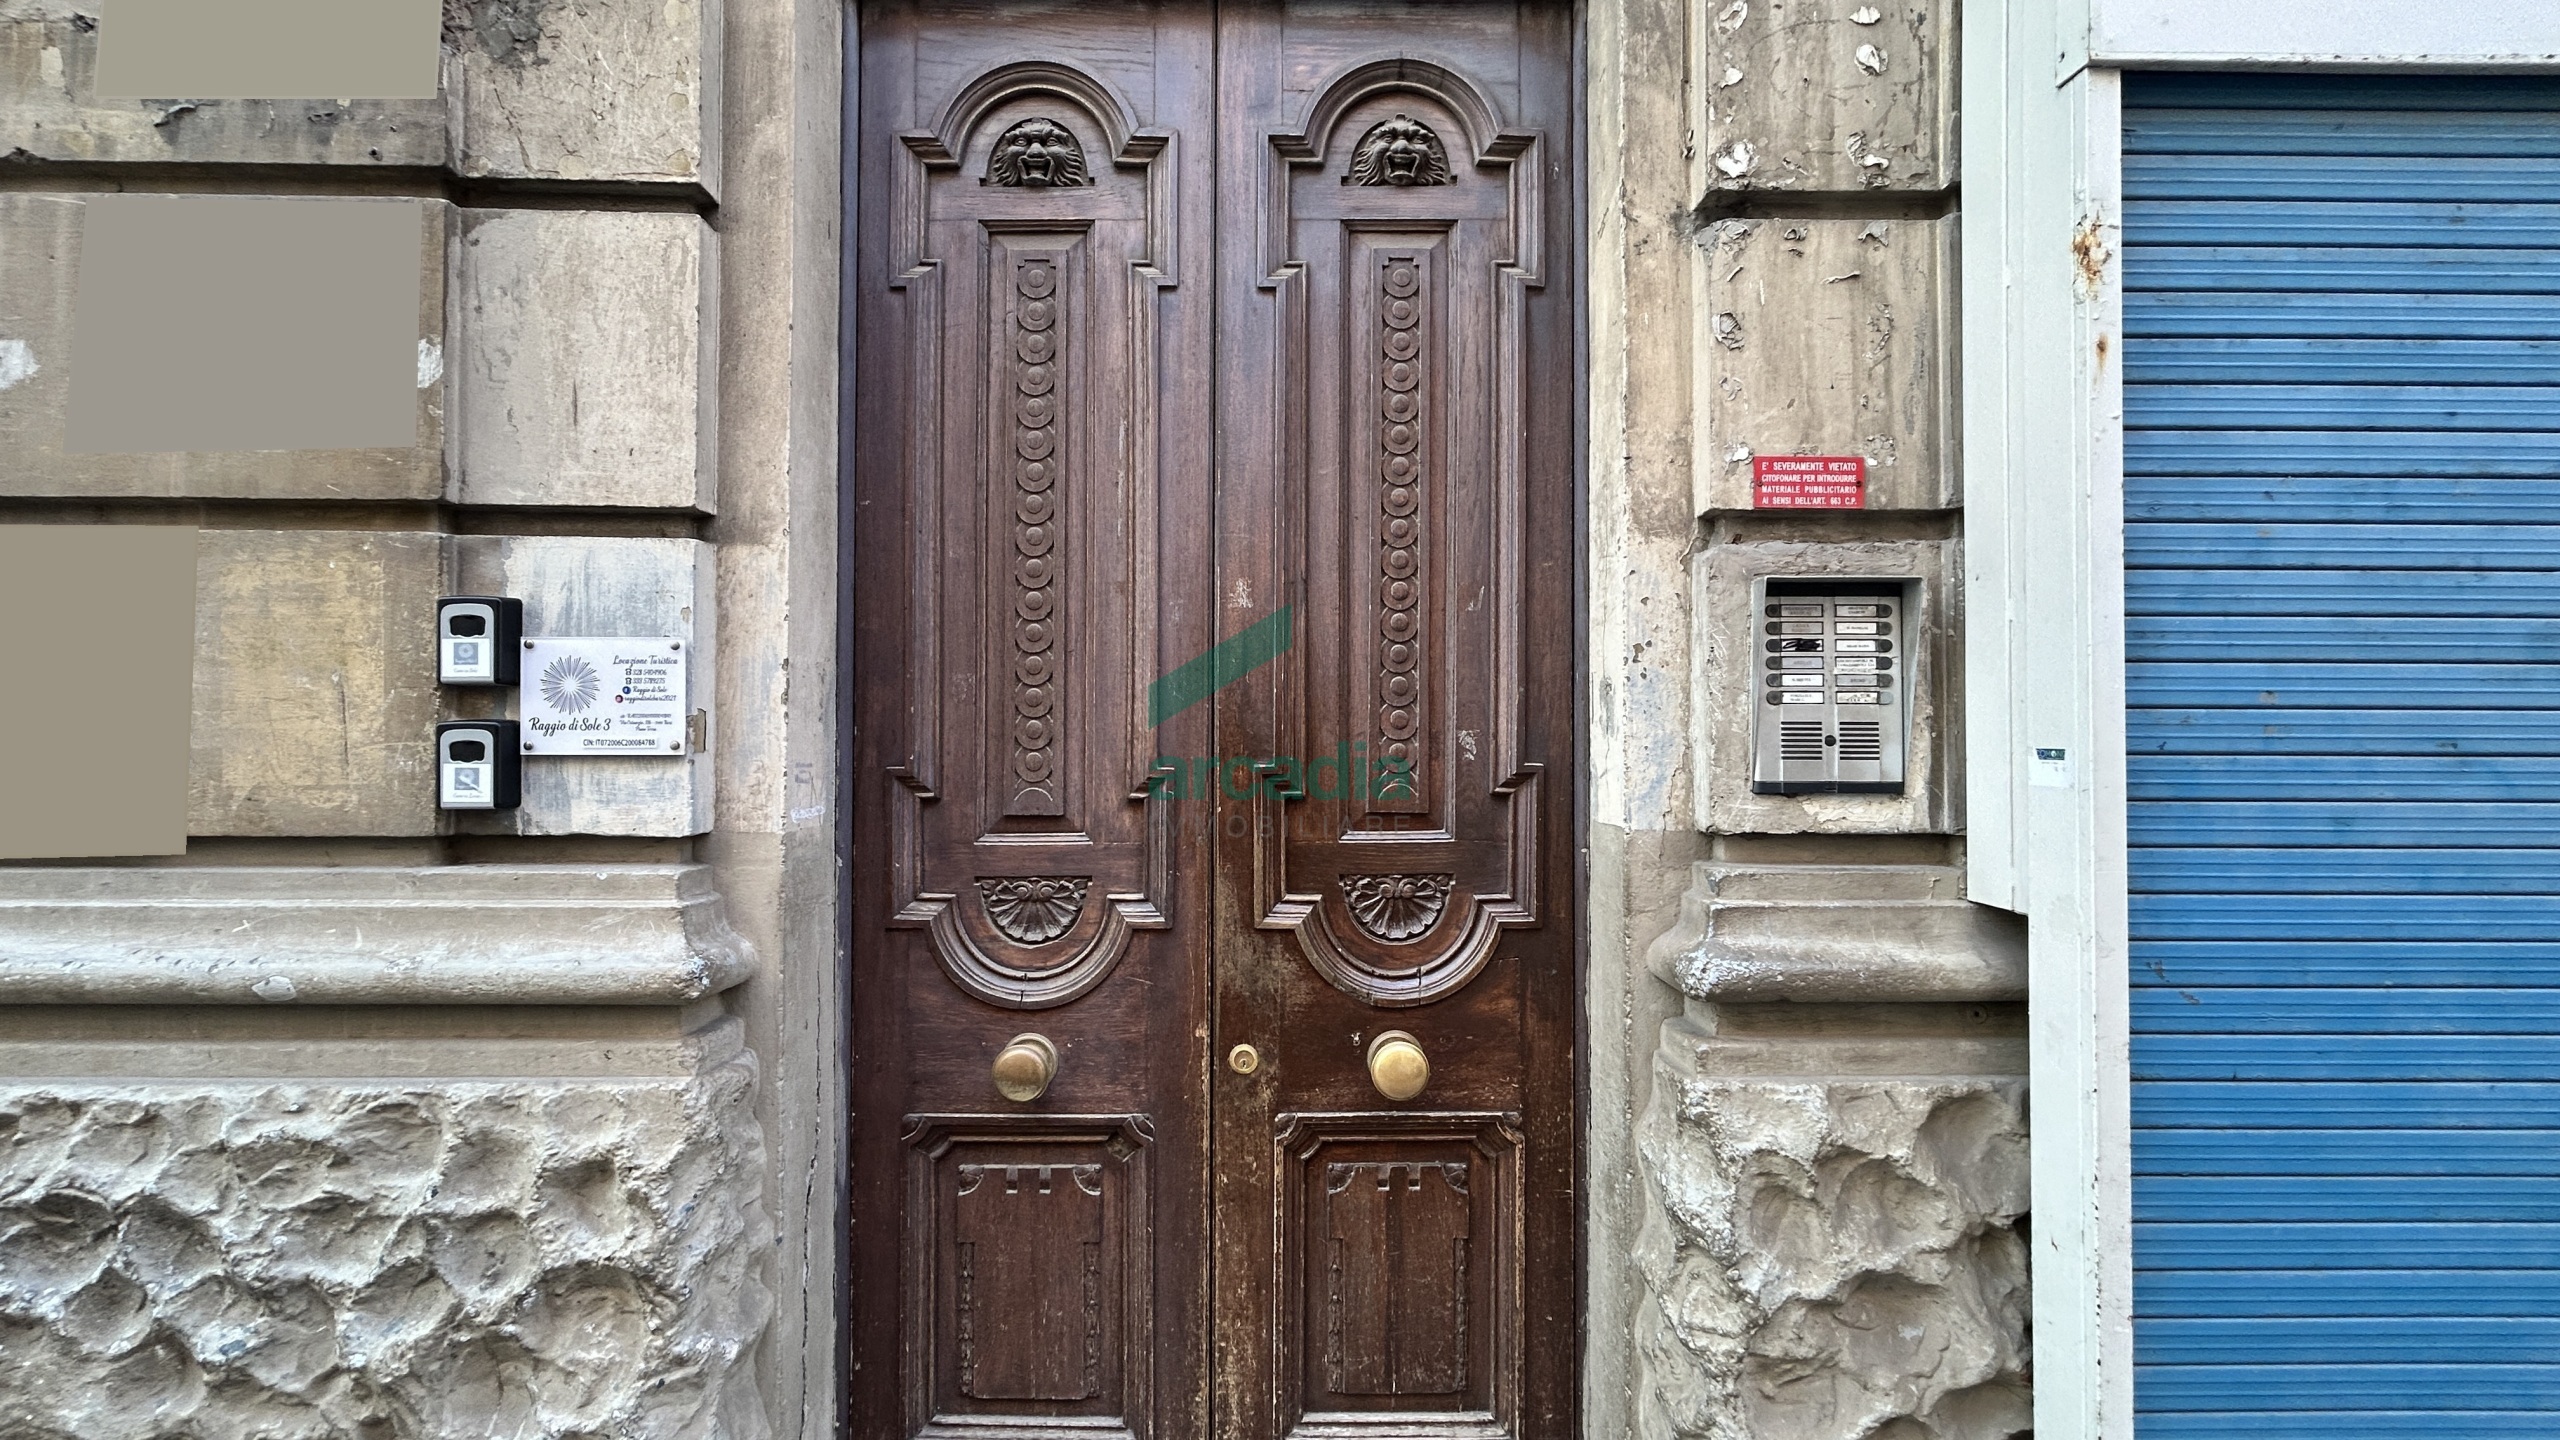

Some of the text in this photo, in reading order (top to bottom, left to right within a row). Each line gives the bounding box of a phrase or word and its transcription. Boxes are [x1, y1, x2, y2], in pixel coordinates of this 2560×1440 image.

[1761, 462, 1857, 471] E' SEVERAMENTE VIETATO
[1761, 474, 1857, 483] CITOFONARE PER INTRODURRE
[1761, 485, 1857, 494] MATERIALE PUBBLICITARIO
[1761, 497, 1769, 505] AI
[1772, 497, 1792, 505] SENSI
[1794, 497, 1827, 505] DELL'ART.
[1844, 497, 1857, 505] C.P.
[612, 654, 678, 668] Locazione Turistica
[632, 685, 651, 696] Raggio
[656, 685, 667, 693] Sole
[528, 717, 567, 737] Raggio
[568, 717, 579, 731] di
[579, 717, 601, 732] Sole
[602, 717, 612, 731] 3
[583, 738, 594, 747] CIN:
